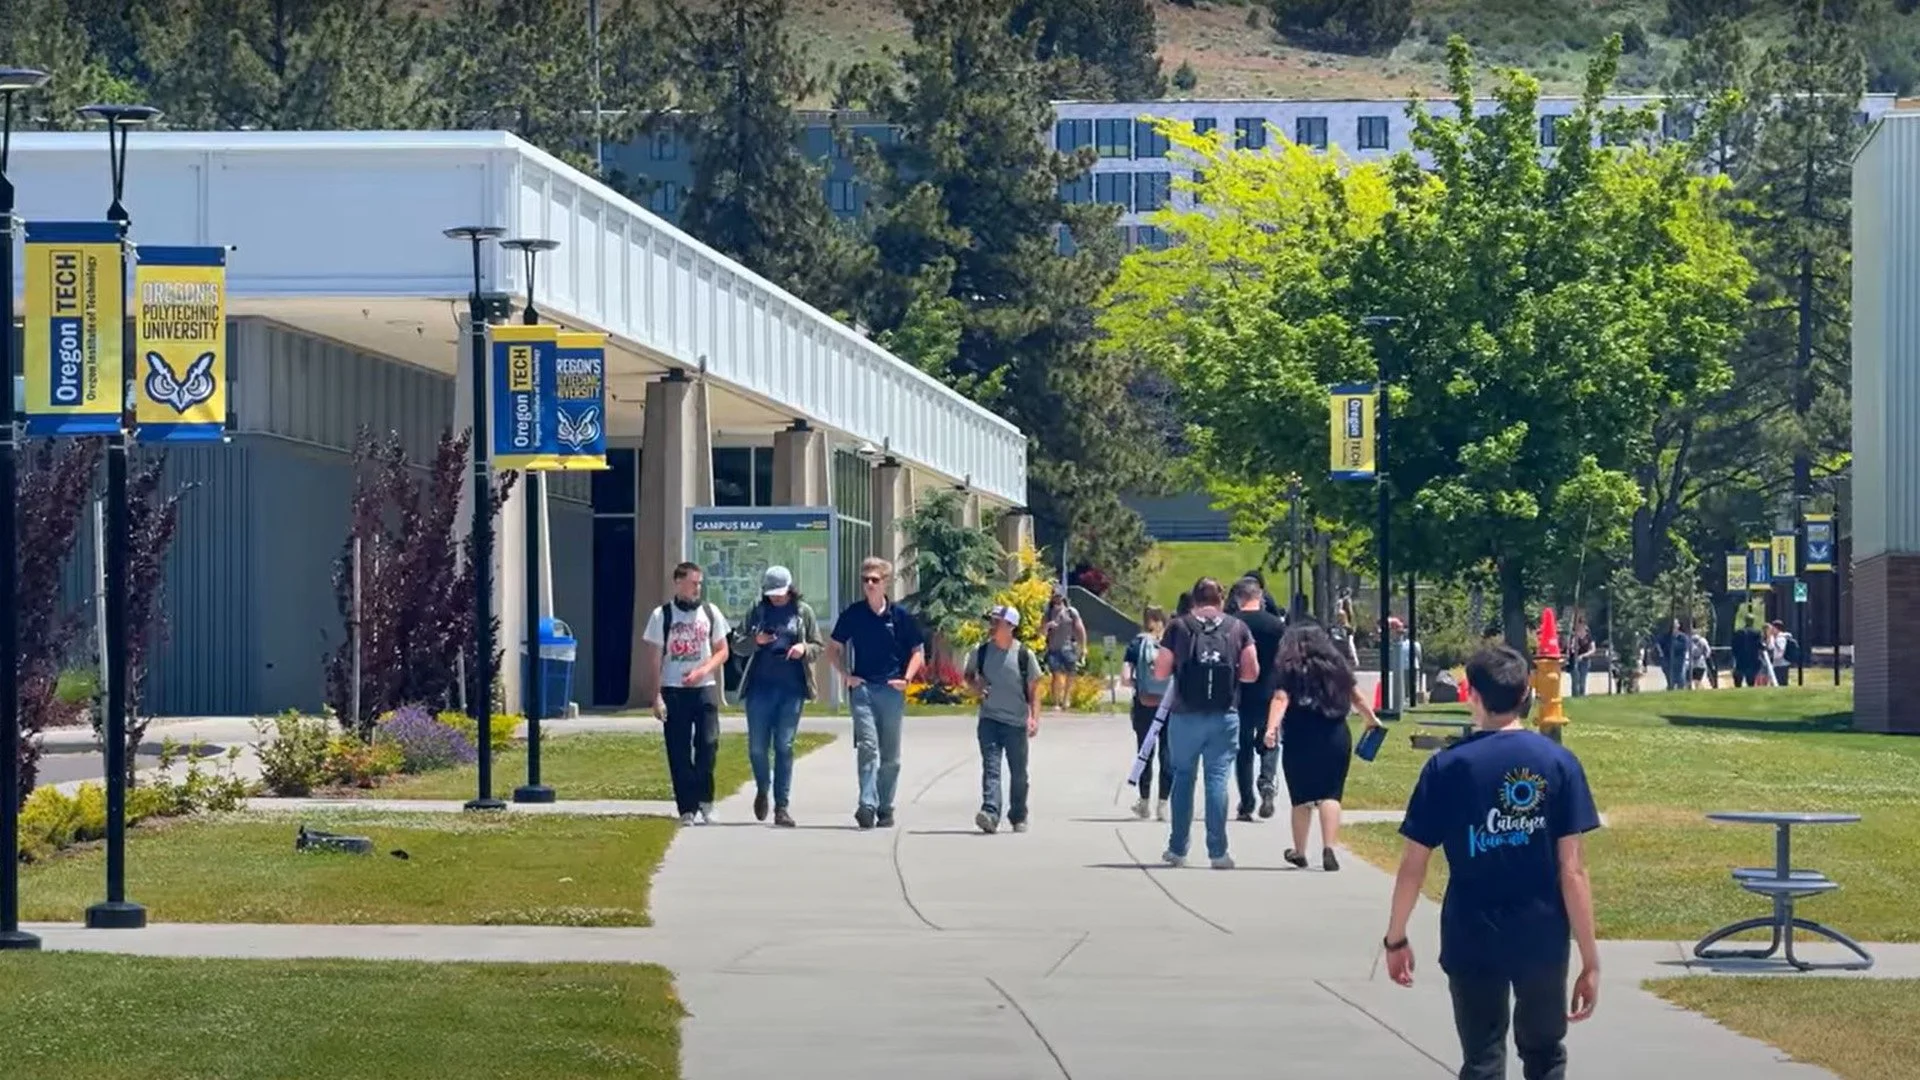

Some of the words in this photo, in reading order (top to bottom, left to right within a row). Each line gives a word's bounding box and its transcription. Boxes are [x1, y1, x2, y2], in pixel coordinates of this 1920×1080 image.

[56, 255, 77, 313] TECH
[86, 256, 97, 309] Technology
[142, 283, 218, 305] OREGON'S
[86, 312, 96, 321] of
[143, 304, 219, 320] POLYTECHNIC
[143, 322, 219, 340] UNIVERSITY
[56, 323, 82, 401] Oregon
[513, 349, 528, 387] TECH
[556, 358, 601, 374] REGON'S
[86, 366, 97, 400] Oregon
[514, 394, 532, 447] Oregon
[1349, 400, 1361, 436] Oregon
[1351, 441, 1361, 467] TECH
[695, 521, 738, 530] CAMPUS
[741, 521, 763, 529] MAP
